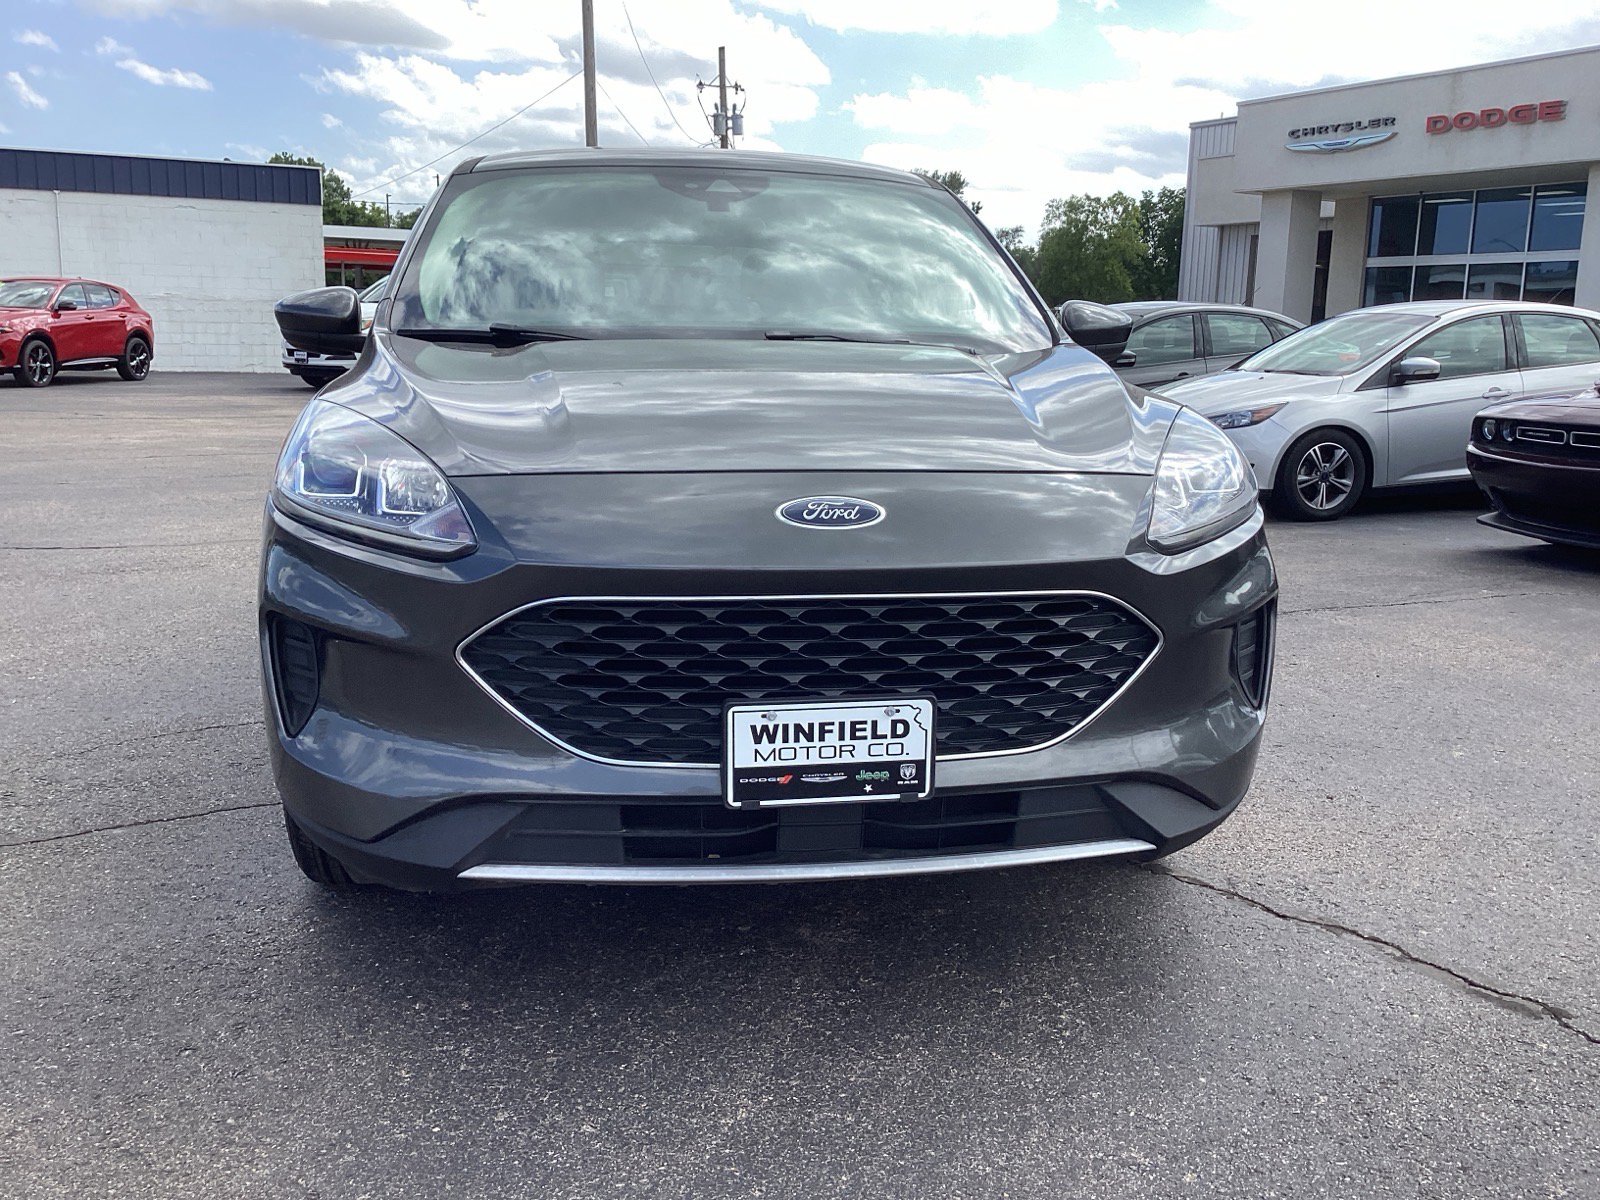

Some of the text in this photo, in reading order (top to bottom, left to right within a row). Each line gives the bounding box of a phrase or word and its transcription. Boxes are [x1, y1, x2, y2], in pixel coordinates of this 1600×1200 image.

[1288, 116, 1396, 139] CHRYSLER
[1425, 99, 1567, 135] DODGE
[802, 501, 860, 520] Ford
[750, 719, 911, 745] WINFIELD
[754, 742, 910, 762] MOTOR CO.
[856, 769, 890, 782] Jeep
